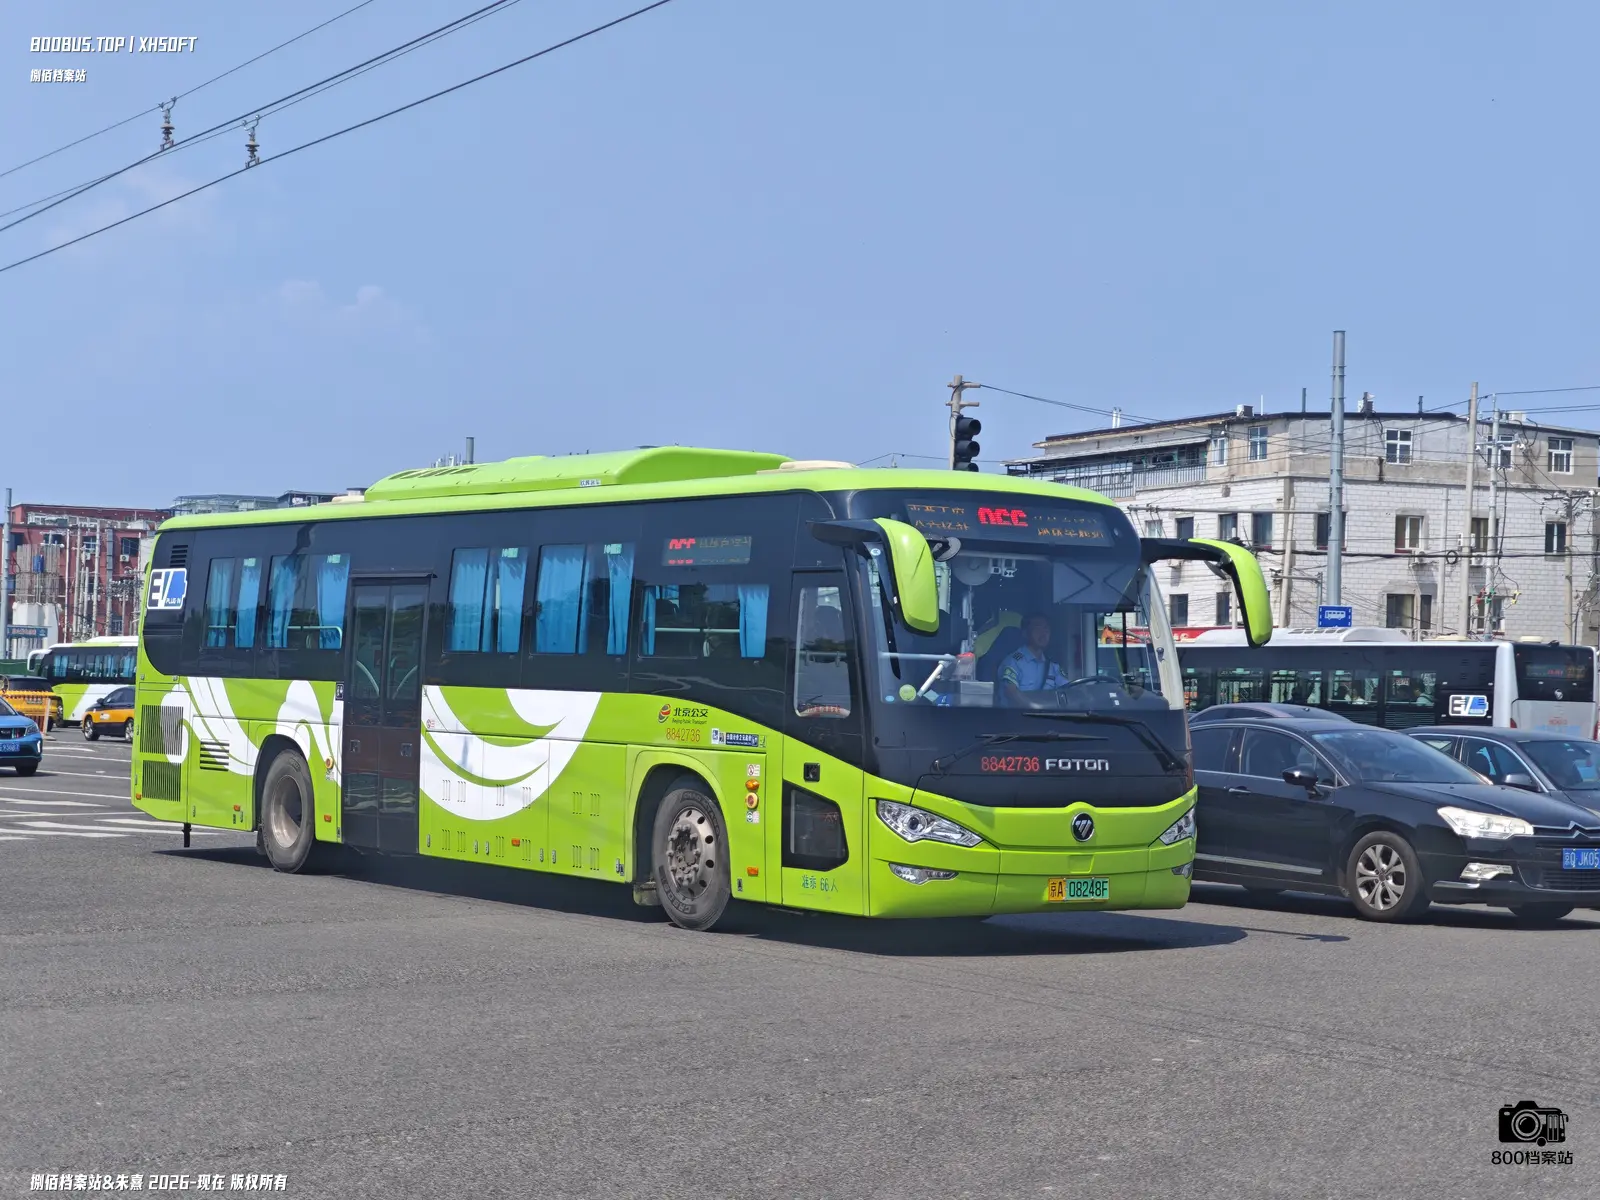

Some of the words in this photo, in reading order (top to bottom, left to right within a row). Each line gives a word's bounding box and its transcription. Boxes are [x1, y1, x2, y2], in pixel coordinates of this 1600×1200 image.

[673, 707, 709, 718] 北京公交
[666, 727, 701, 742] 8842736
[981, 756, 1040, 772] 8842736
[1045, 758, 1110, 771] FOTON
